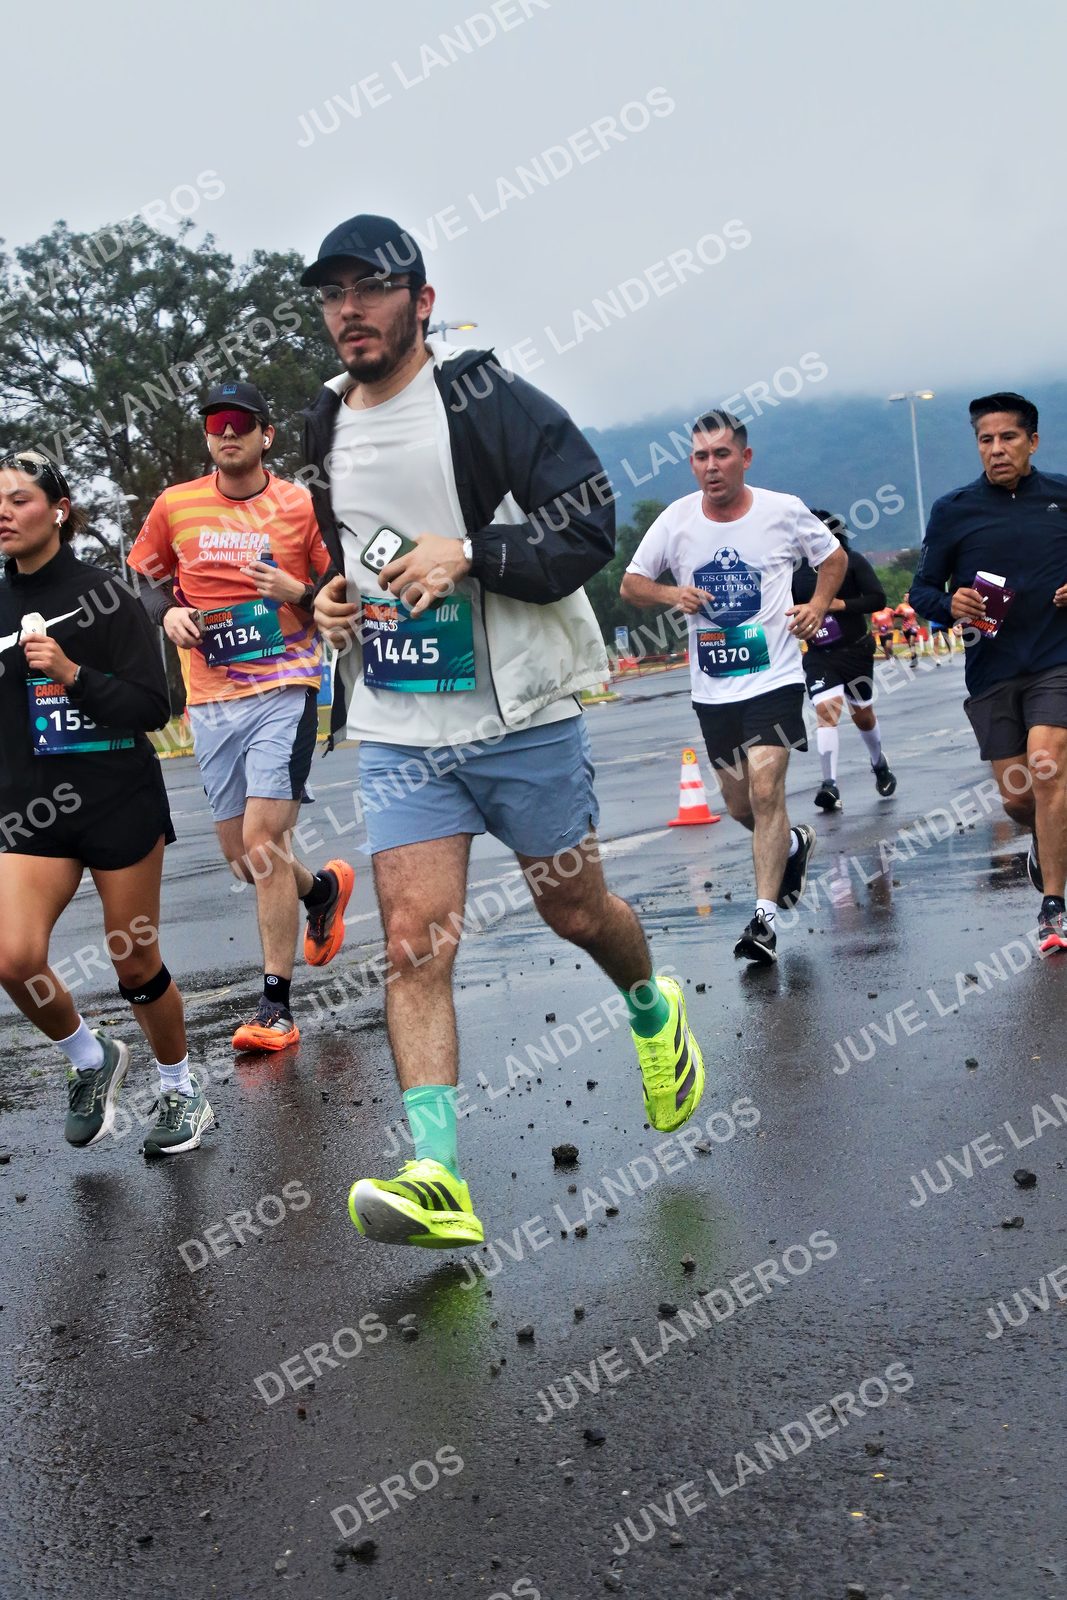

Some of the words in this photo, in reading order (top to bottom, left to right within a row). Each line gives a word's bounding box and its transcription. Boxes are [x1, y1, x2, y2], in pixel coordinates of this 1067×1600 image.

[199, 551, 252, 561] OMNILIFE
[702, 574, 752, 582] ESCUELA
[204, 611, 233, 625] ARRERA
[436, 604, 459, 622] 10K
[213, 626, 261, 649] 1134
[744, 627, 758, 639] 10K
[373, 637, 440, 664] 1445
[708, 647, 750, 664] 1370
[36, 696, 70, 706] OMNILIFE
